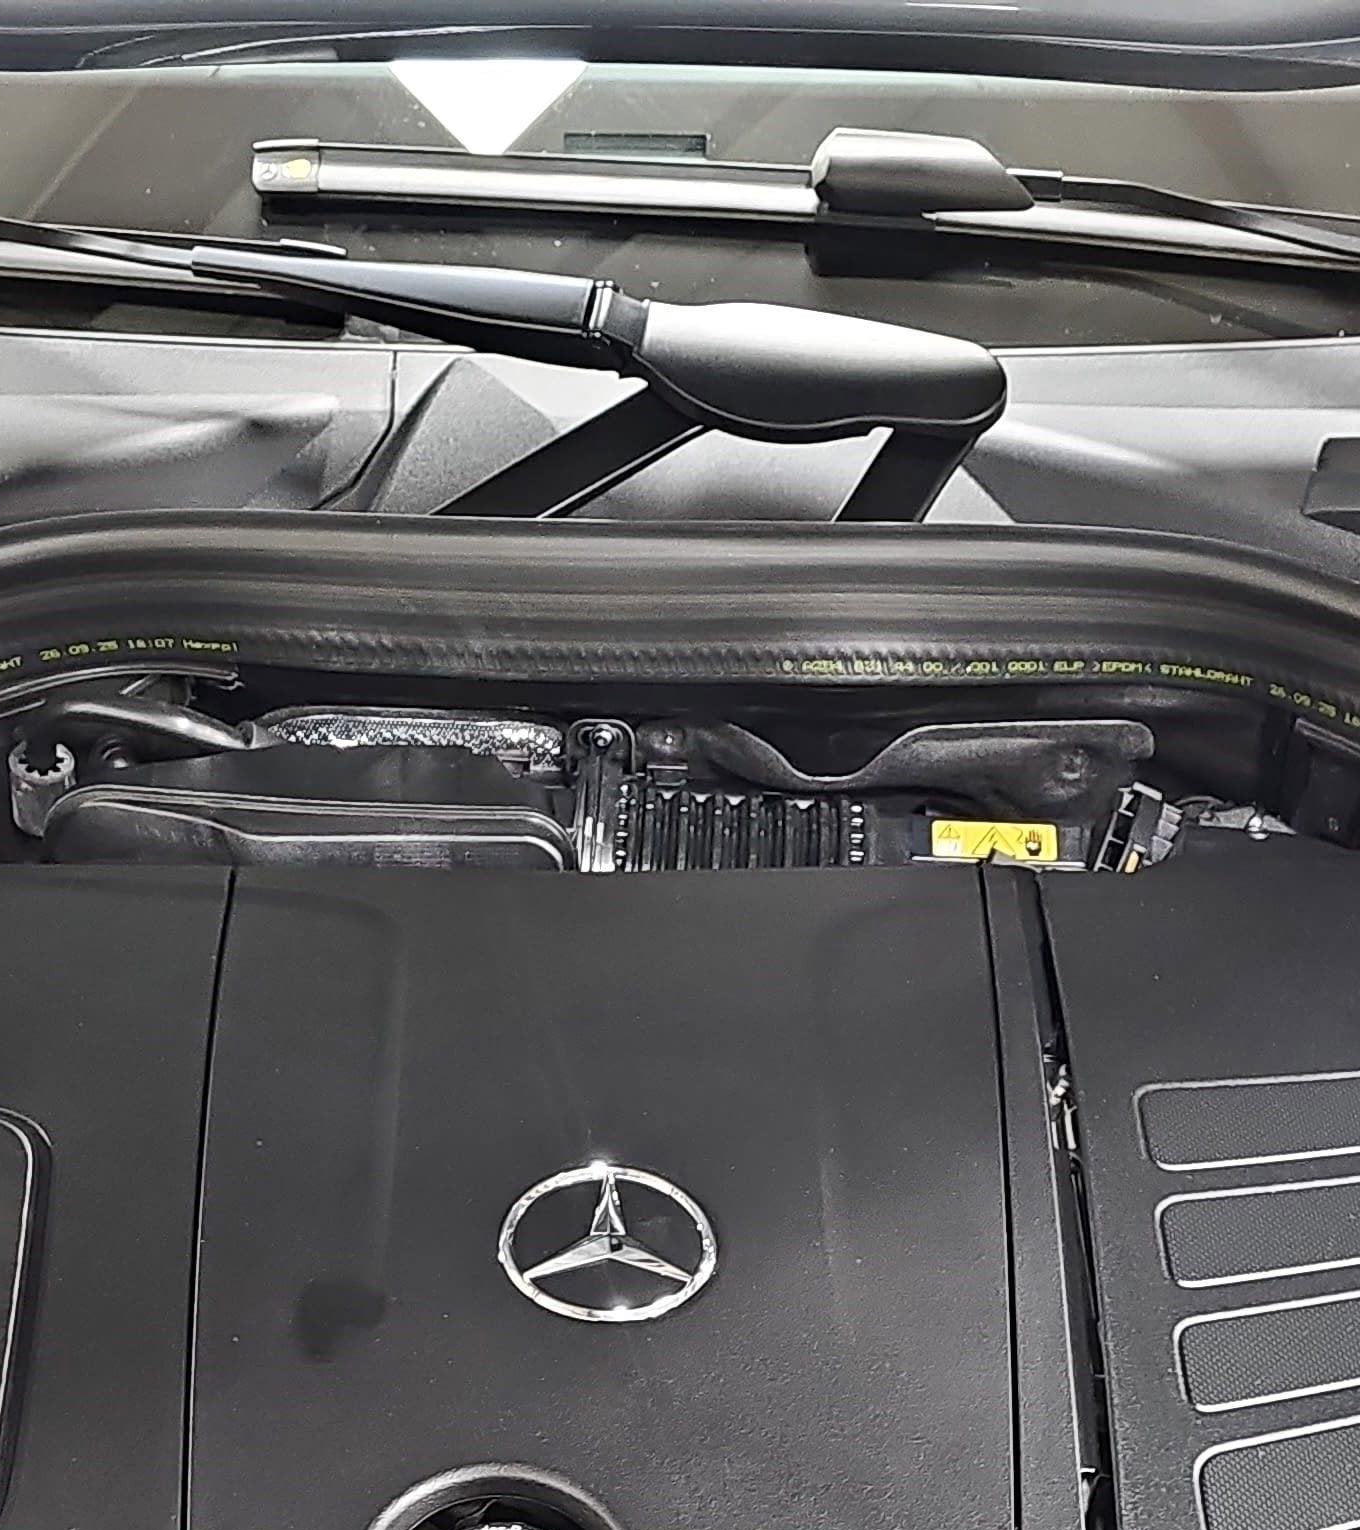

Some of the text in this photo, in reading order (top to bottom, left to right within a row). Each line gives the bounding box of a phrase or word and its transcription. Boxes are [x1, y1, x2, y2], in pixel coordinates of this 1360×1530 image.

[922, 660, 944, 673] 00
[1053, 660, 1085, 673] ELP
[1159, 663, 1254, 687] STAHLDRAHT
